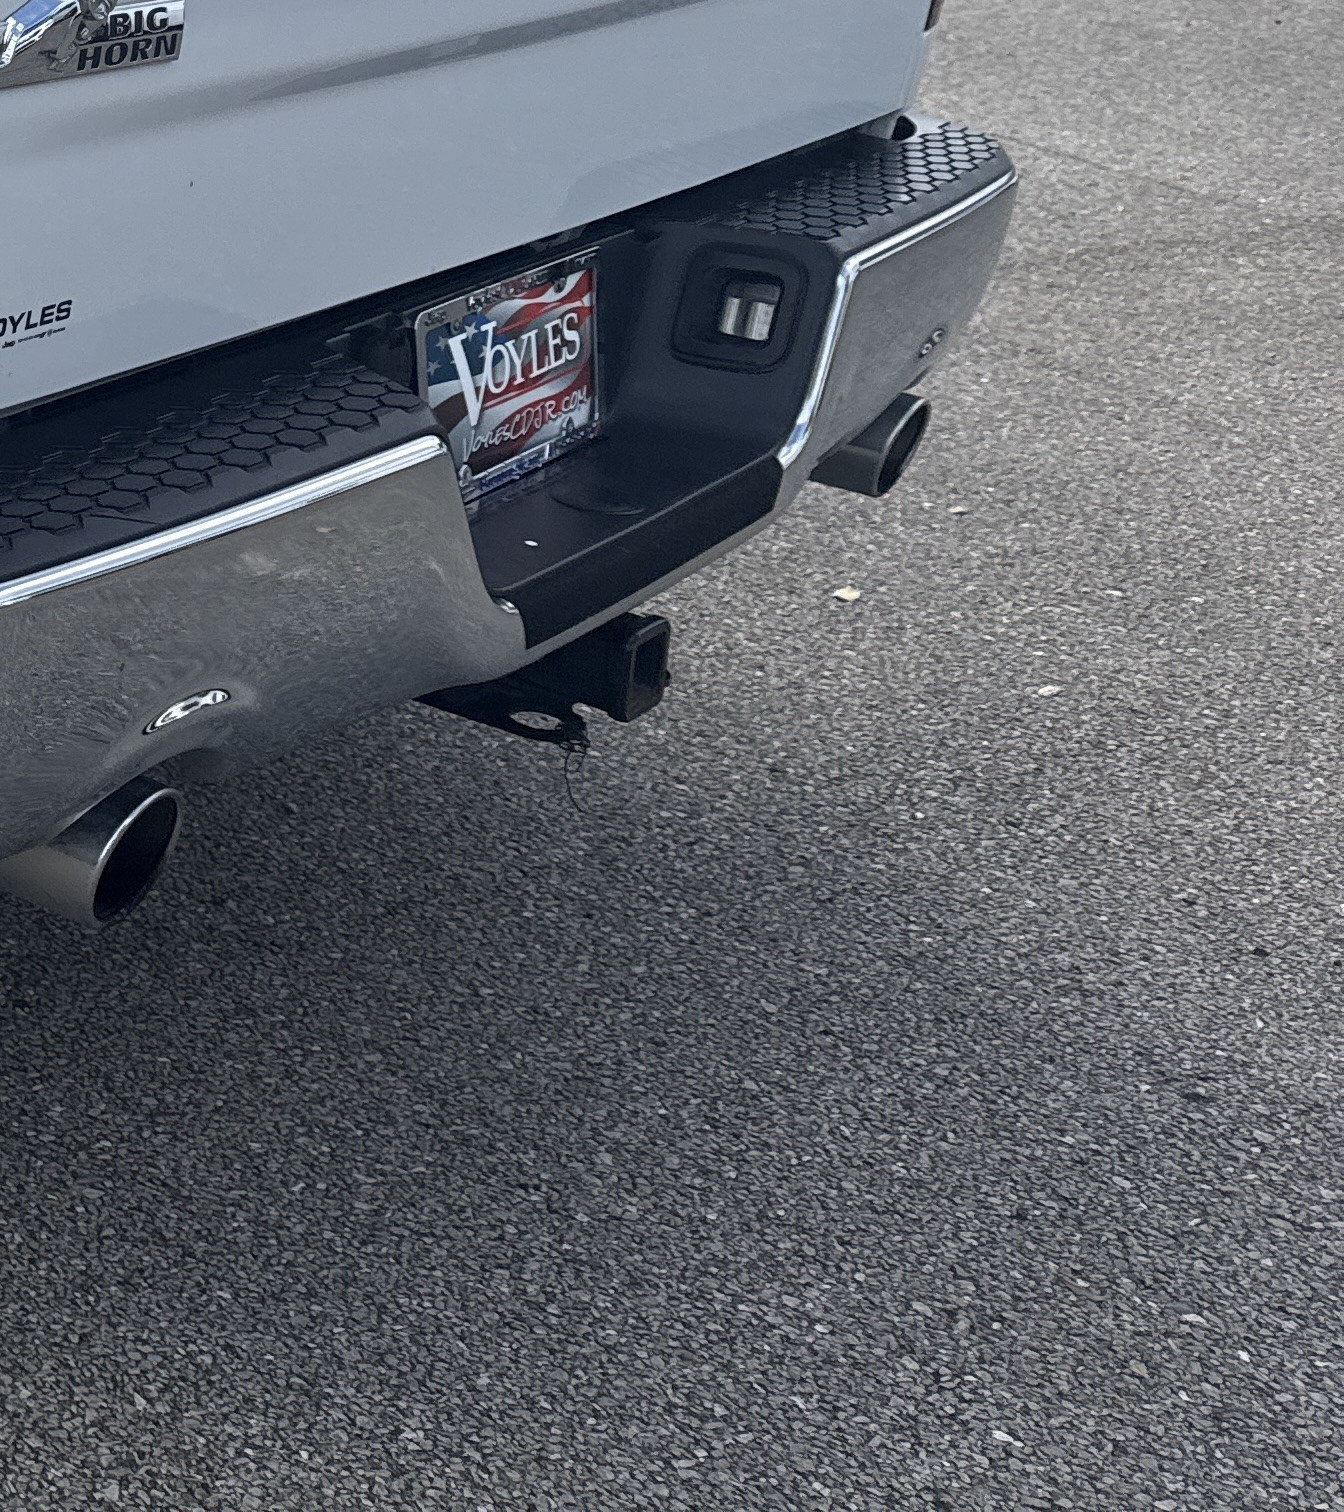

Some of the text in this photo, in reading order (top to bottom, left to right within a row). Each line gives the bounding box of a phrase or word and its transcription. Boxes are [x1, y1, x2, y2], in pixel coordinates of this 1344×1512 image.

[109, 6, 169, 39] BIG
[76, 33, 178, 72] HORN
[448, 312, 581, 428] VOYLES
